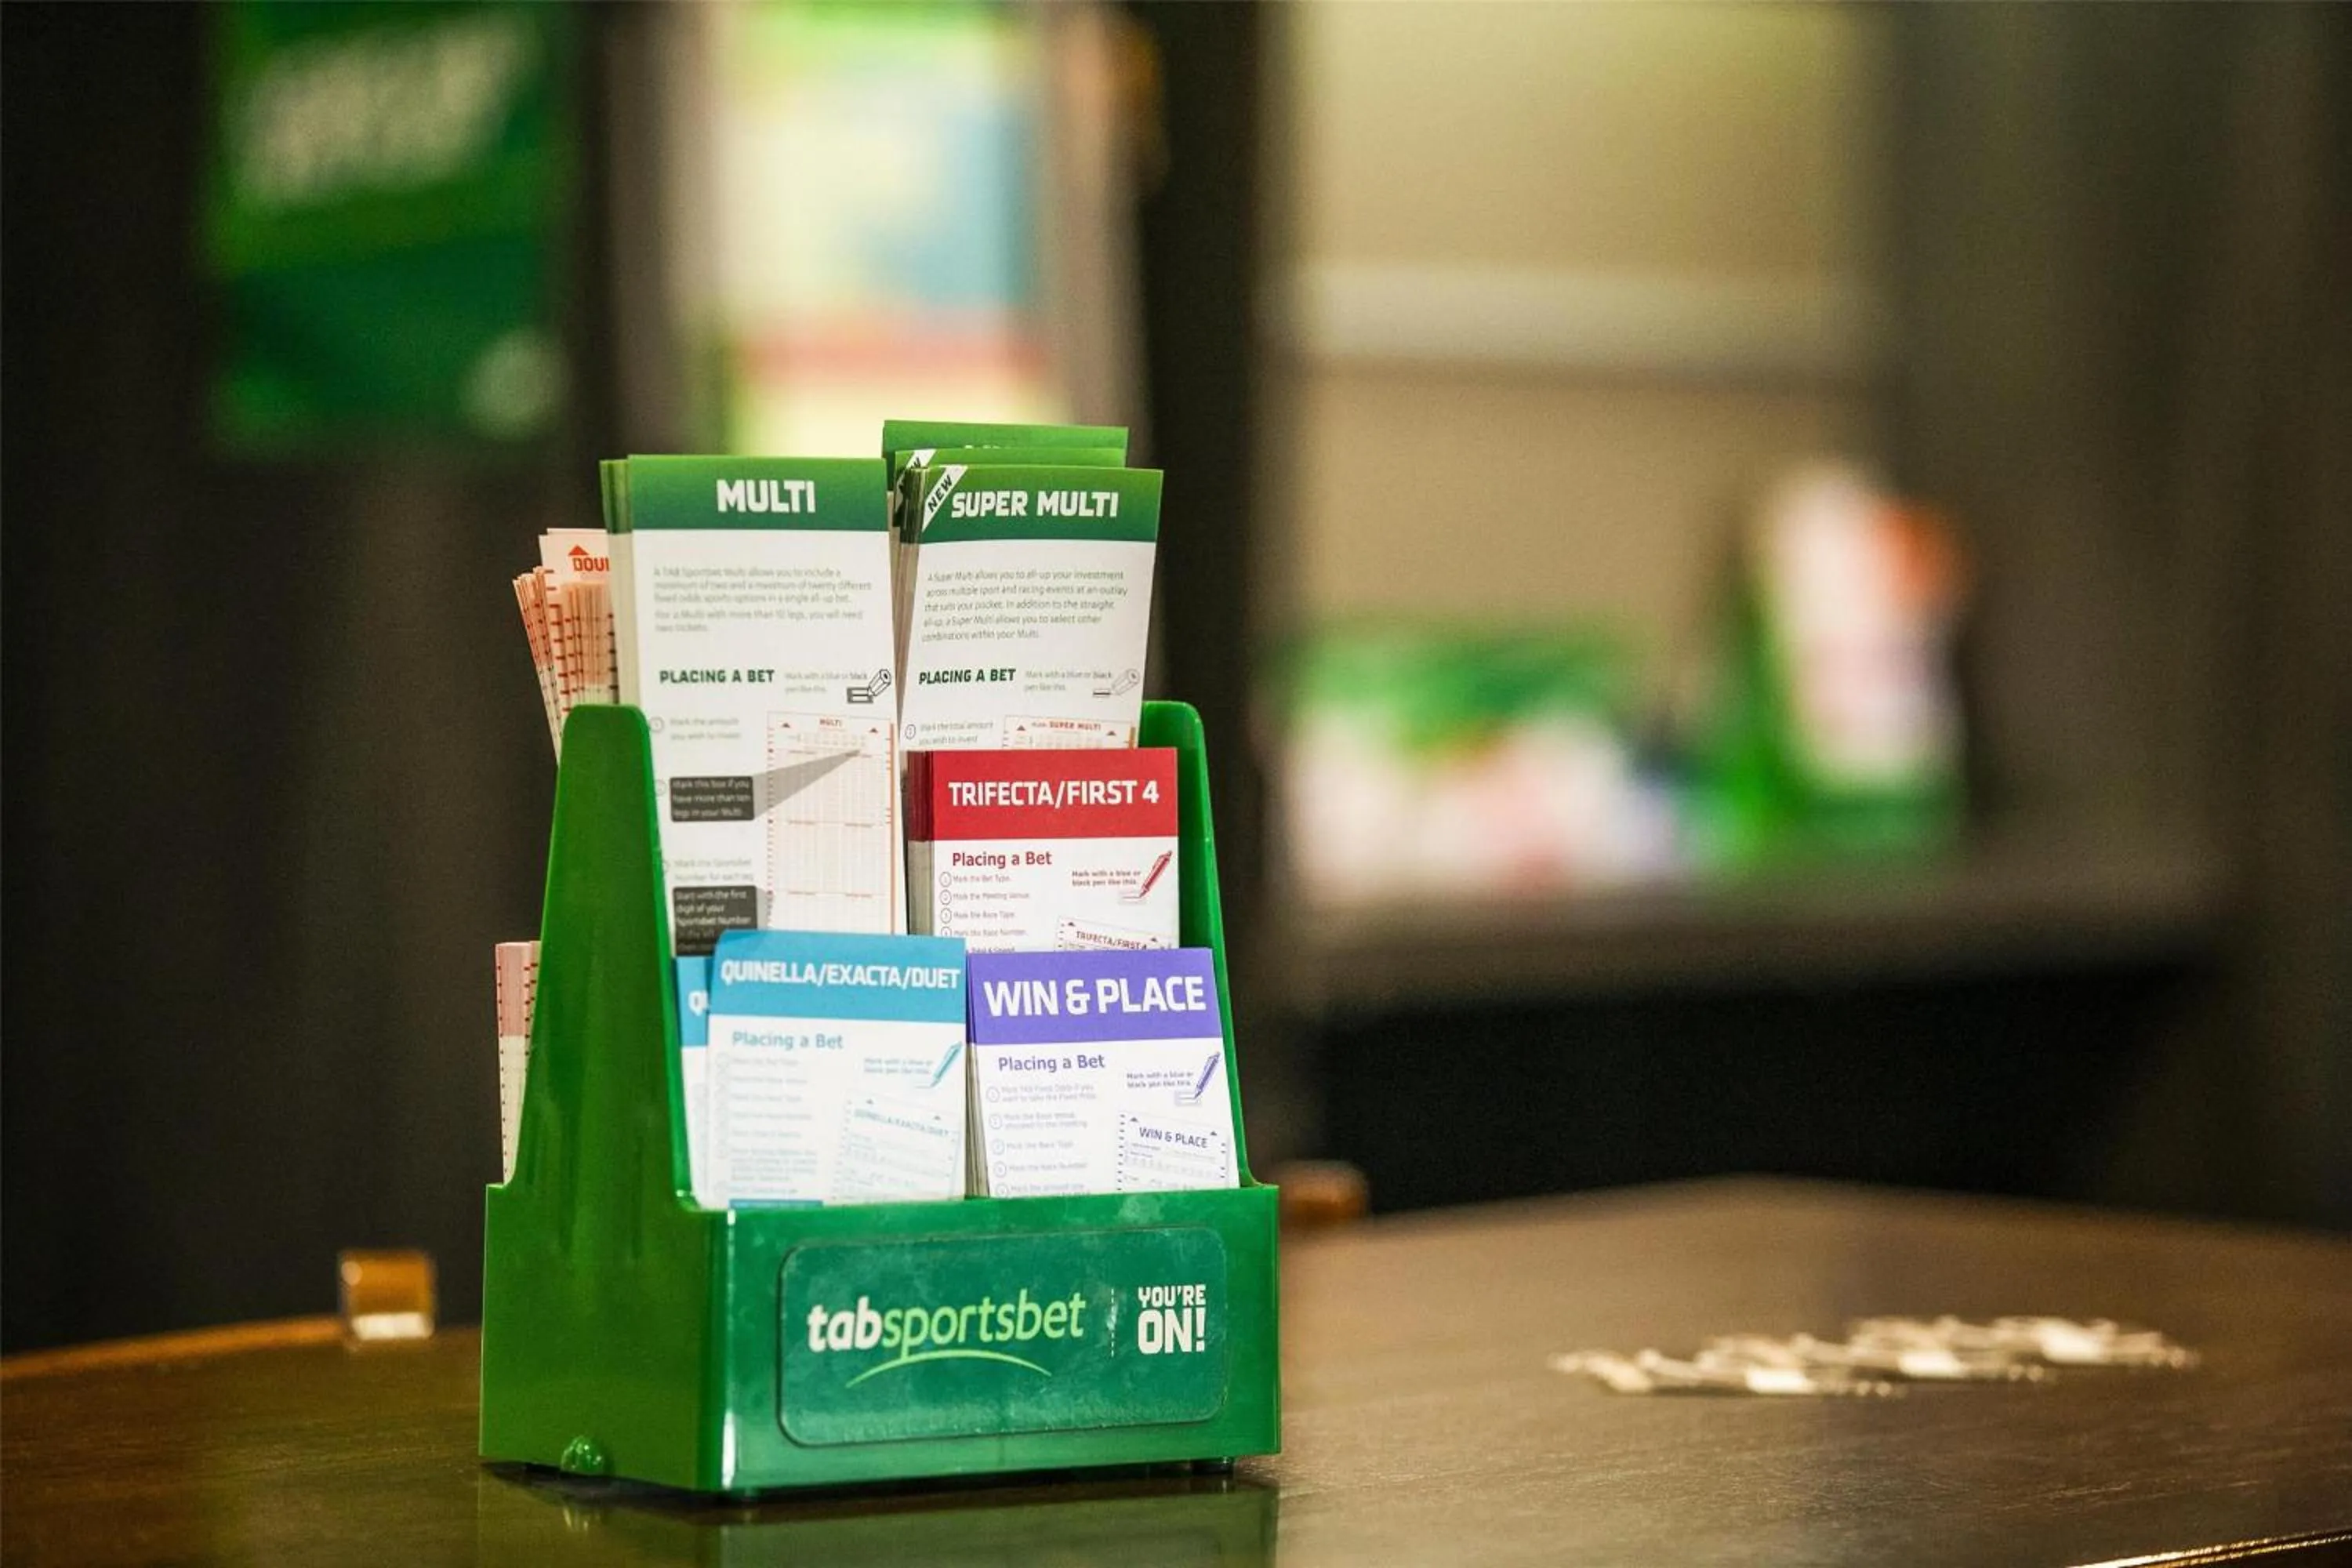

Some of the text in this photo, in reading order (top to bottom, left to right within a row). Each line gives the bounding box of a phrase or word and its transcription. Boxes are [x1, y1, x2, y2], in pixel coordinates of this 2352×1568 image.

[717, 480, 815, 513] MULTI
[927, 474, 953, 513] NEW
[951, 490, 1119, 518] SUPER MULTI
[659, 670, 726, 683] PLACING
[732, 670, 742, 682] A
[747, 670, 775, 682] BET
[919, 668, 1016, 684] PLACING A BET
[1050, 720, 1075, 729] SUPER
[1077, 722, 1102, 731] MULTI
[948, 780, 1160, 809] TRIFECTA/FIRST 4
[952, 851, 1053, 869] Placing a Bet
[1076, 930, 1141, 950] TRIFECTA/FIRST
[720, 959, 961, 990] QUINELLA/EXACTA/DUET
[688, 990, 710, 1017] Q
[983, 976, 1207, 1017] WIN & PLACE
[732, 1029, 844, 1051] Placing a Bet
[998, 1054, 1105, 1073] Placing a Bet
[1139, 1126, 1163, 1141] WIN
[1165, 1131, 1173, 1143] &
[1175, 1132, 1208, 1149] PLACE
[1138, 1284, 1207, 1308] YOU'RE
[807, 1287, 1086, 1359] tabsportsbet
[1137, 1305, 1207, 1356] ON!
